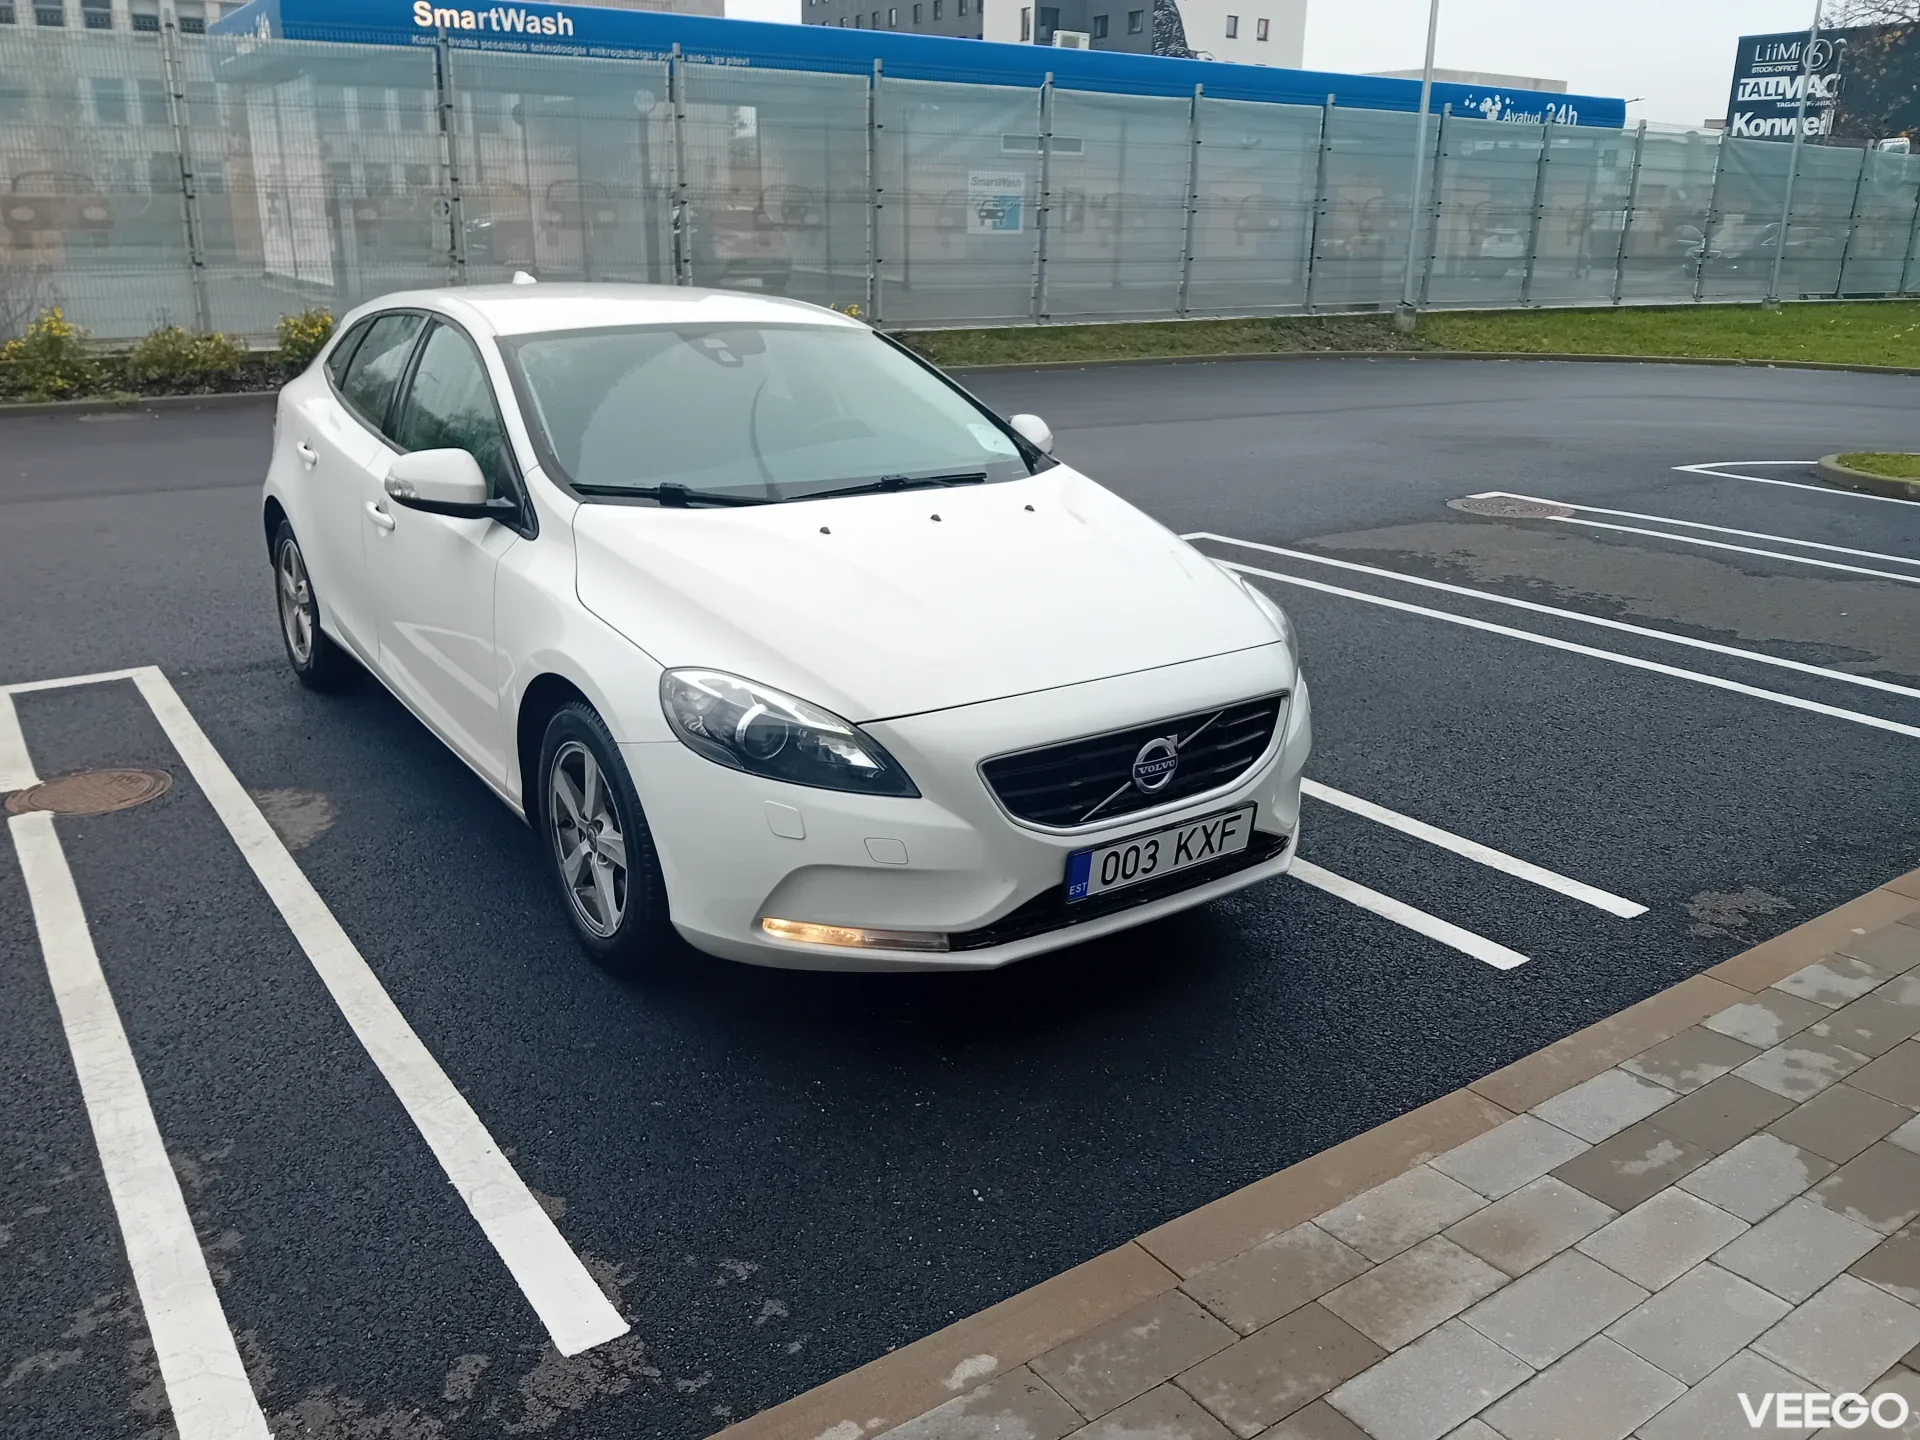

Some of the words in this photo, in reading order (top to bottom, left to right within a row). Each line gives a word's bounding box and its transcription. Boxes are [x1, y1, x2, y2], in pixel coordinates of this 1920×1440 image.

[413, 0, 573, 36] SmartWash
[1751, 65, 1799, 73] STOCK-OFFICE
[1737, 73, 1842, 101] TALLMAC
[1502, 108, 1541, 125] Avatud
[1138, 759, 1175, 774] VOLVO
[1101, 839, 1160, 886] 003
[1173, 814, 1242, 866] KXF
[1069, 881, 1088, 896] EST
